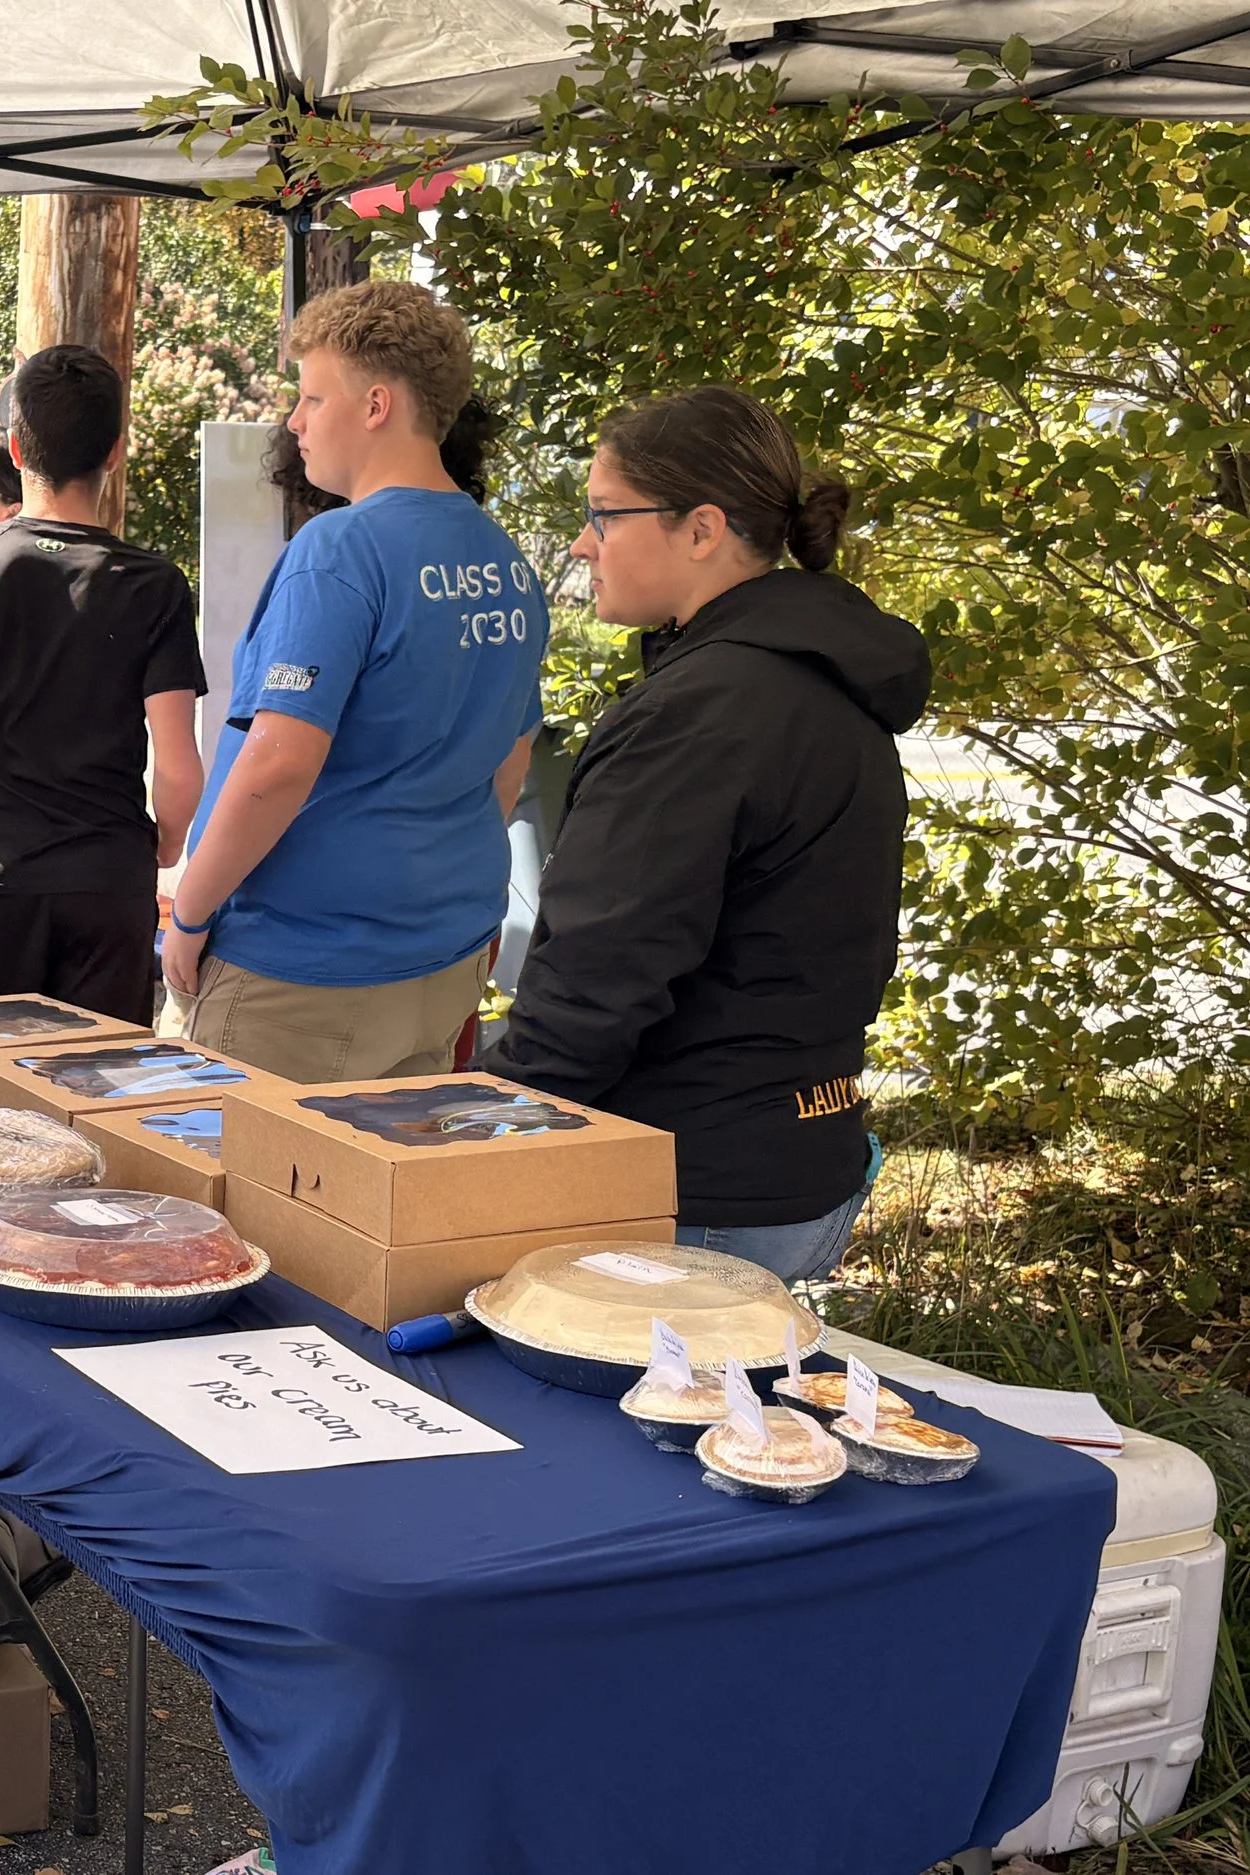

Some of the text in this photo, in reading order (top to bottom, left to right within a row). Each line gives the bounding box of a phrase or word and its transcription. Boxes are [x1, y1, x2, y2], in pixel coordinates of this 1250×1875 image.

[419, 562, 502, 601] CLASS
[459, 608, 527, 649] 2030
[279, 1341, 462, 1436] Ask us about
